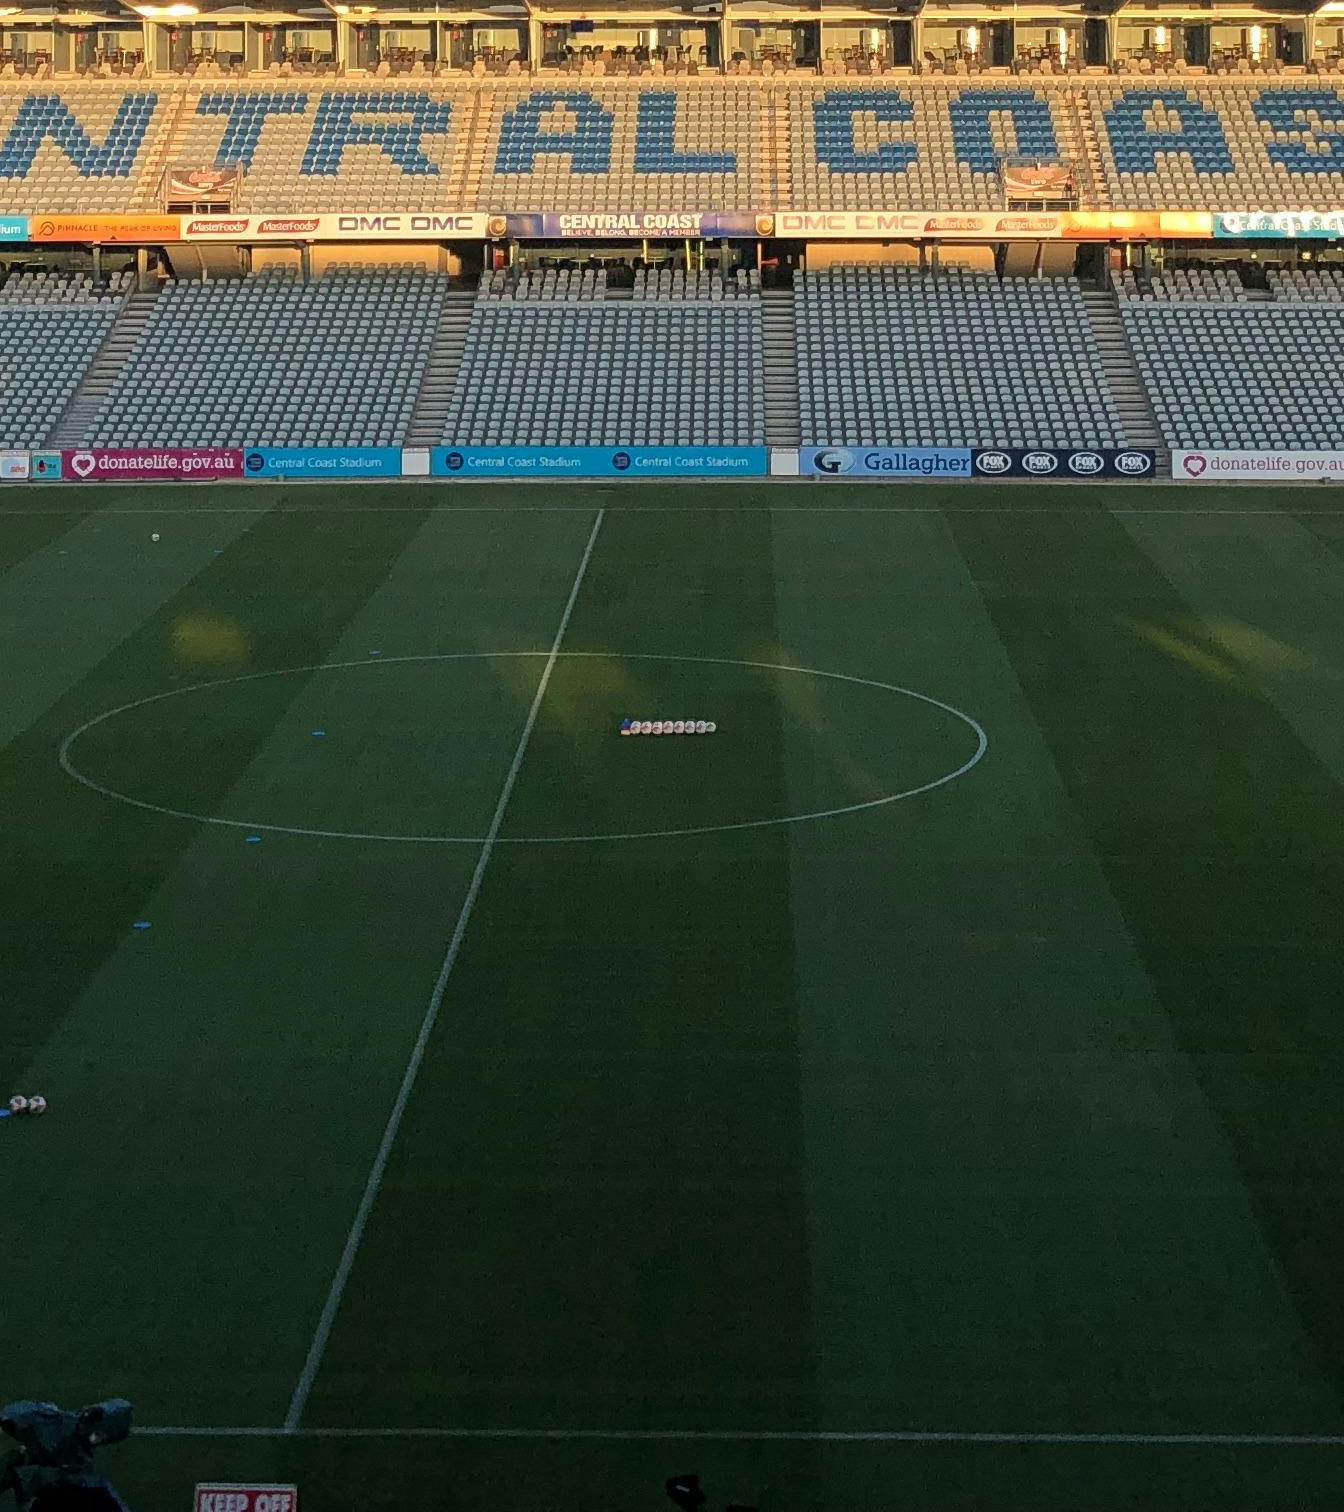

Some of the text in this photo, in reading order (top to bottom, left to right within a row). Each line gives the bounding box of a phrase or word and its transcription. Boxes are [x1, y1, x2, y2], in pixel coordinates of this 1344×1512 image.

[559, 213, 703, 229] CENTRAL COAST
[98, 453, 234, 473] donatelife.gov.au
[268, 457, 382, 468] Central Coast Stadium
[468, 456, 581, 467] Central Coast Stadium
[635, 456, 749, 467] Central Coast Stadium
[864, 451, 970, 474] Gallagher
[200, 1493, 292, 1512] KEEP OFF
